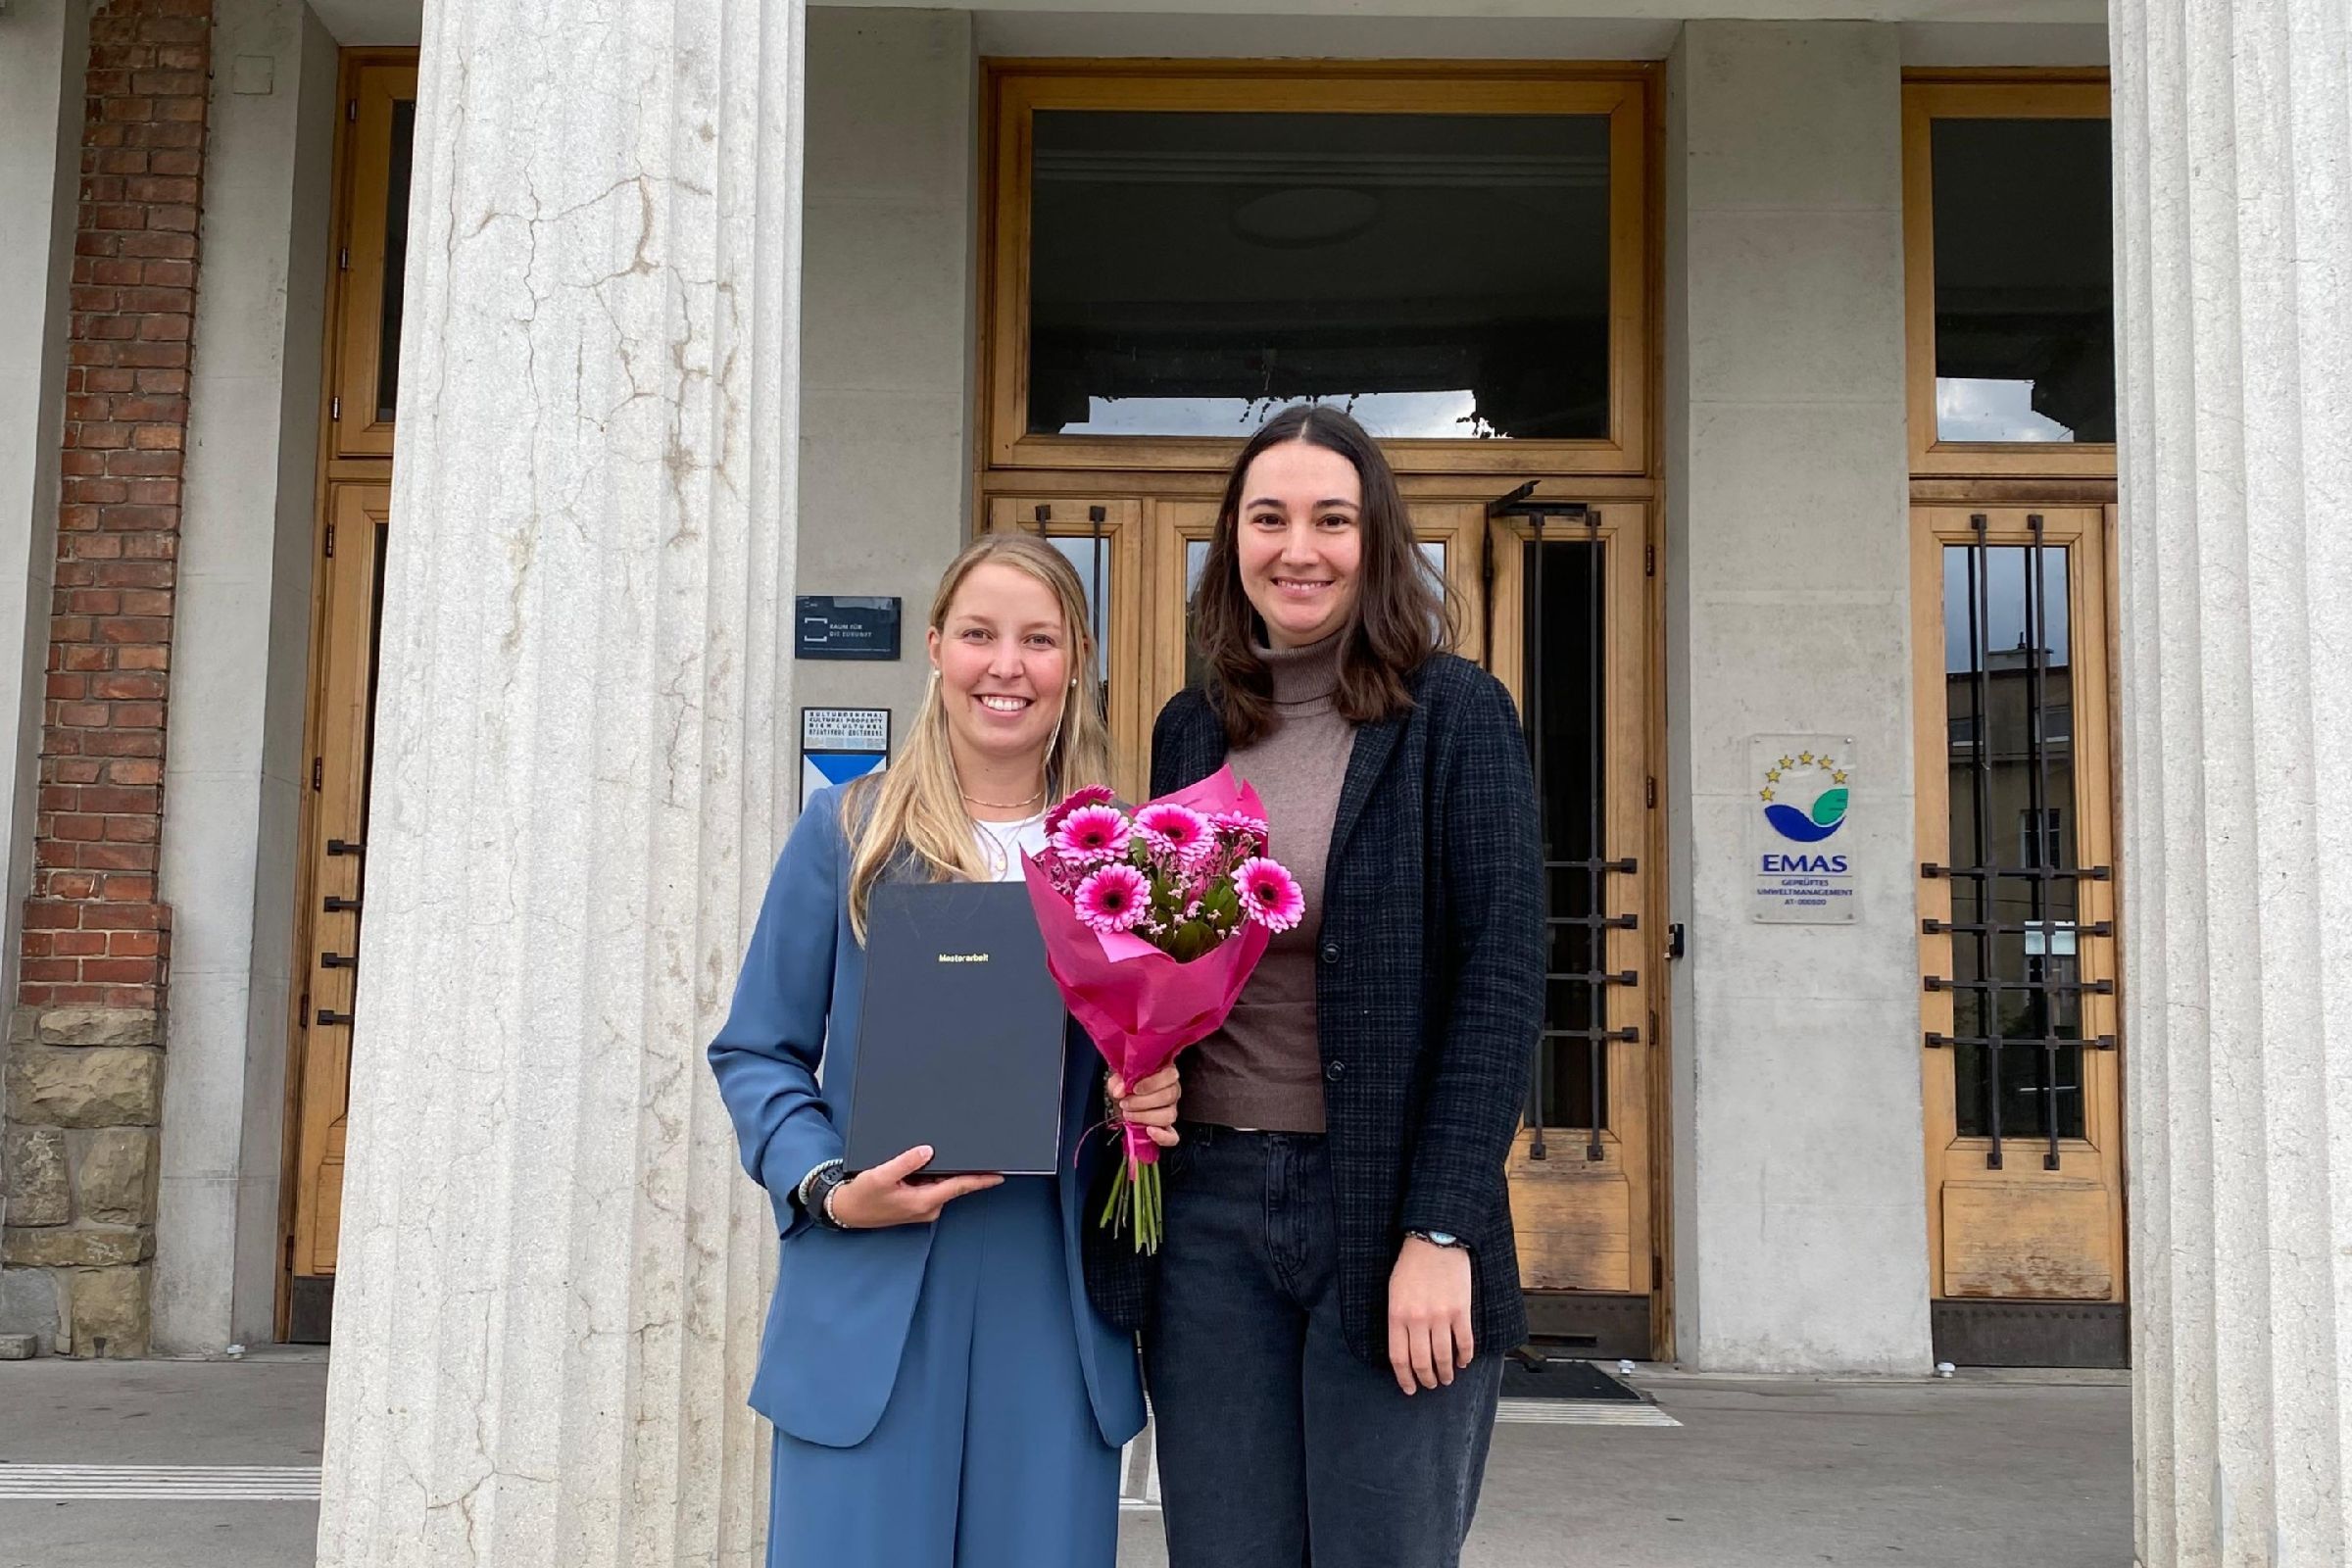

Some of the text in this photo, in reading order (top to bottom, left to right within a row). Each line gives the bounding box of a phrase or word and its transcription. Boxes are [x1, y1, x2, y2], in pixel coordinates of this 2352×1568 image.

[1763, 855, 1847, 872] EMAS
[1782, 878, 1829, 887] GEPRÜFTES
[939, 954, 989, 962] Masterarbeit
